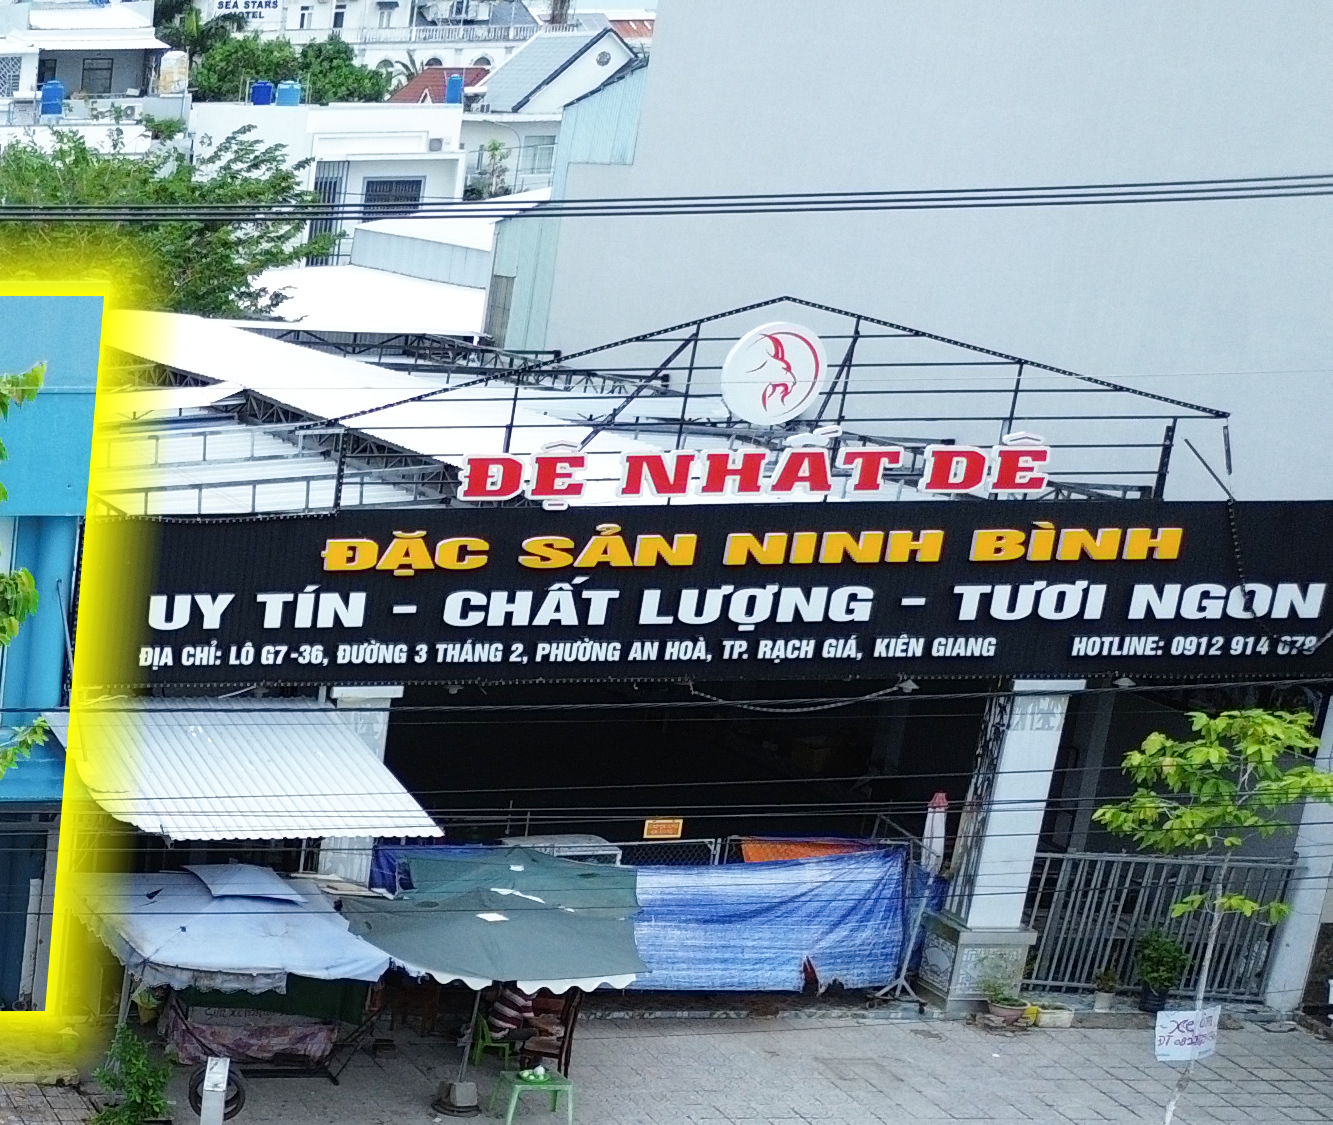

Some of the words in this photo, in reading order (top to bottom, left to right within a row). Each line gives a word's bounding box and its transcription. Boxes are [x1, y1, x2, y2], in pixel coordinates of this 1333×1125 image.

[217, 0, 239, 10] SEA
[244, 1, 278, 10] STARS
[457, 438, 588, 511] ĐỆ
[620, 425, 904, 500] NHẤT
[923, 431, 1049, 493] DÊ
[321, 530, 489, 577] ĐẶC
[518, 523, 697, 570] SẢN
[723, 529, 944, 566] NINH
[969, 521, 1183, 563] BÌNH
[147, 593, 235, 631] UY
[256, 586, 367, 629] TÍN
[393, 604, 417, 614] -
[442, 576, 621, 627] CHẤT
[639, 584, 875, 632] LƯỢNG
[900, 597, 927, 606] -
[952, 583, 1108, 622] TƯƠI
[1128, 583, 1327, 621] NGON
[139, 646, 174, 670] ĐỊA
[181, 640, 221, 666] CHỈ:
[229, 642, 255, 666] LÔ
[337, 641, 408, 665] ĐƯỜNG
[414, 643, 427, 664] 3
[435, 640, 503, 663] THÁNG
[509, 643, 528, 664] 2,
[535, 638, 621, 662] PHƯỜNG
[628, 641, 658, 661] AN
[664, 637, 712, 662] HOÀ,
[723, 640, 749, 660] TP.
[757, 639, 815, 663] RẠCH
[822, 636, 863, 660] GIÁ,
[873, 632, 924, 658] KIÊN
[931, 637, 997, 657] GIANG
[1071, 636, 1165, 656] HOTLINE:
[1171, 636, 1224, 656] 0912
[1230, 636, 1269, 656] 914
